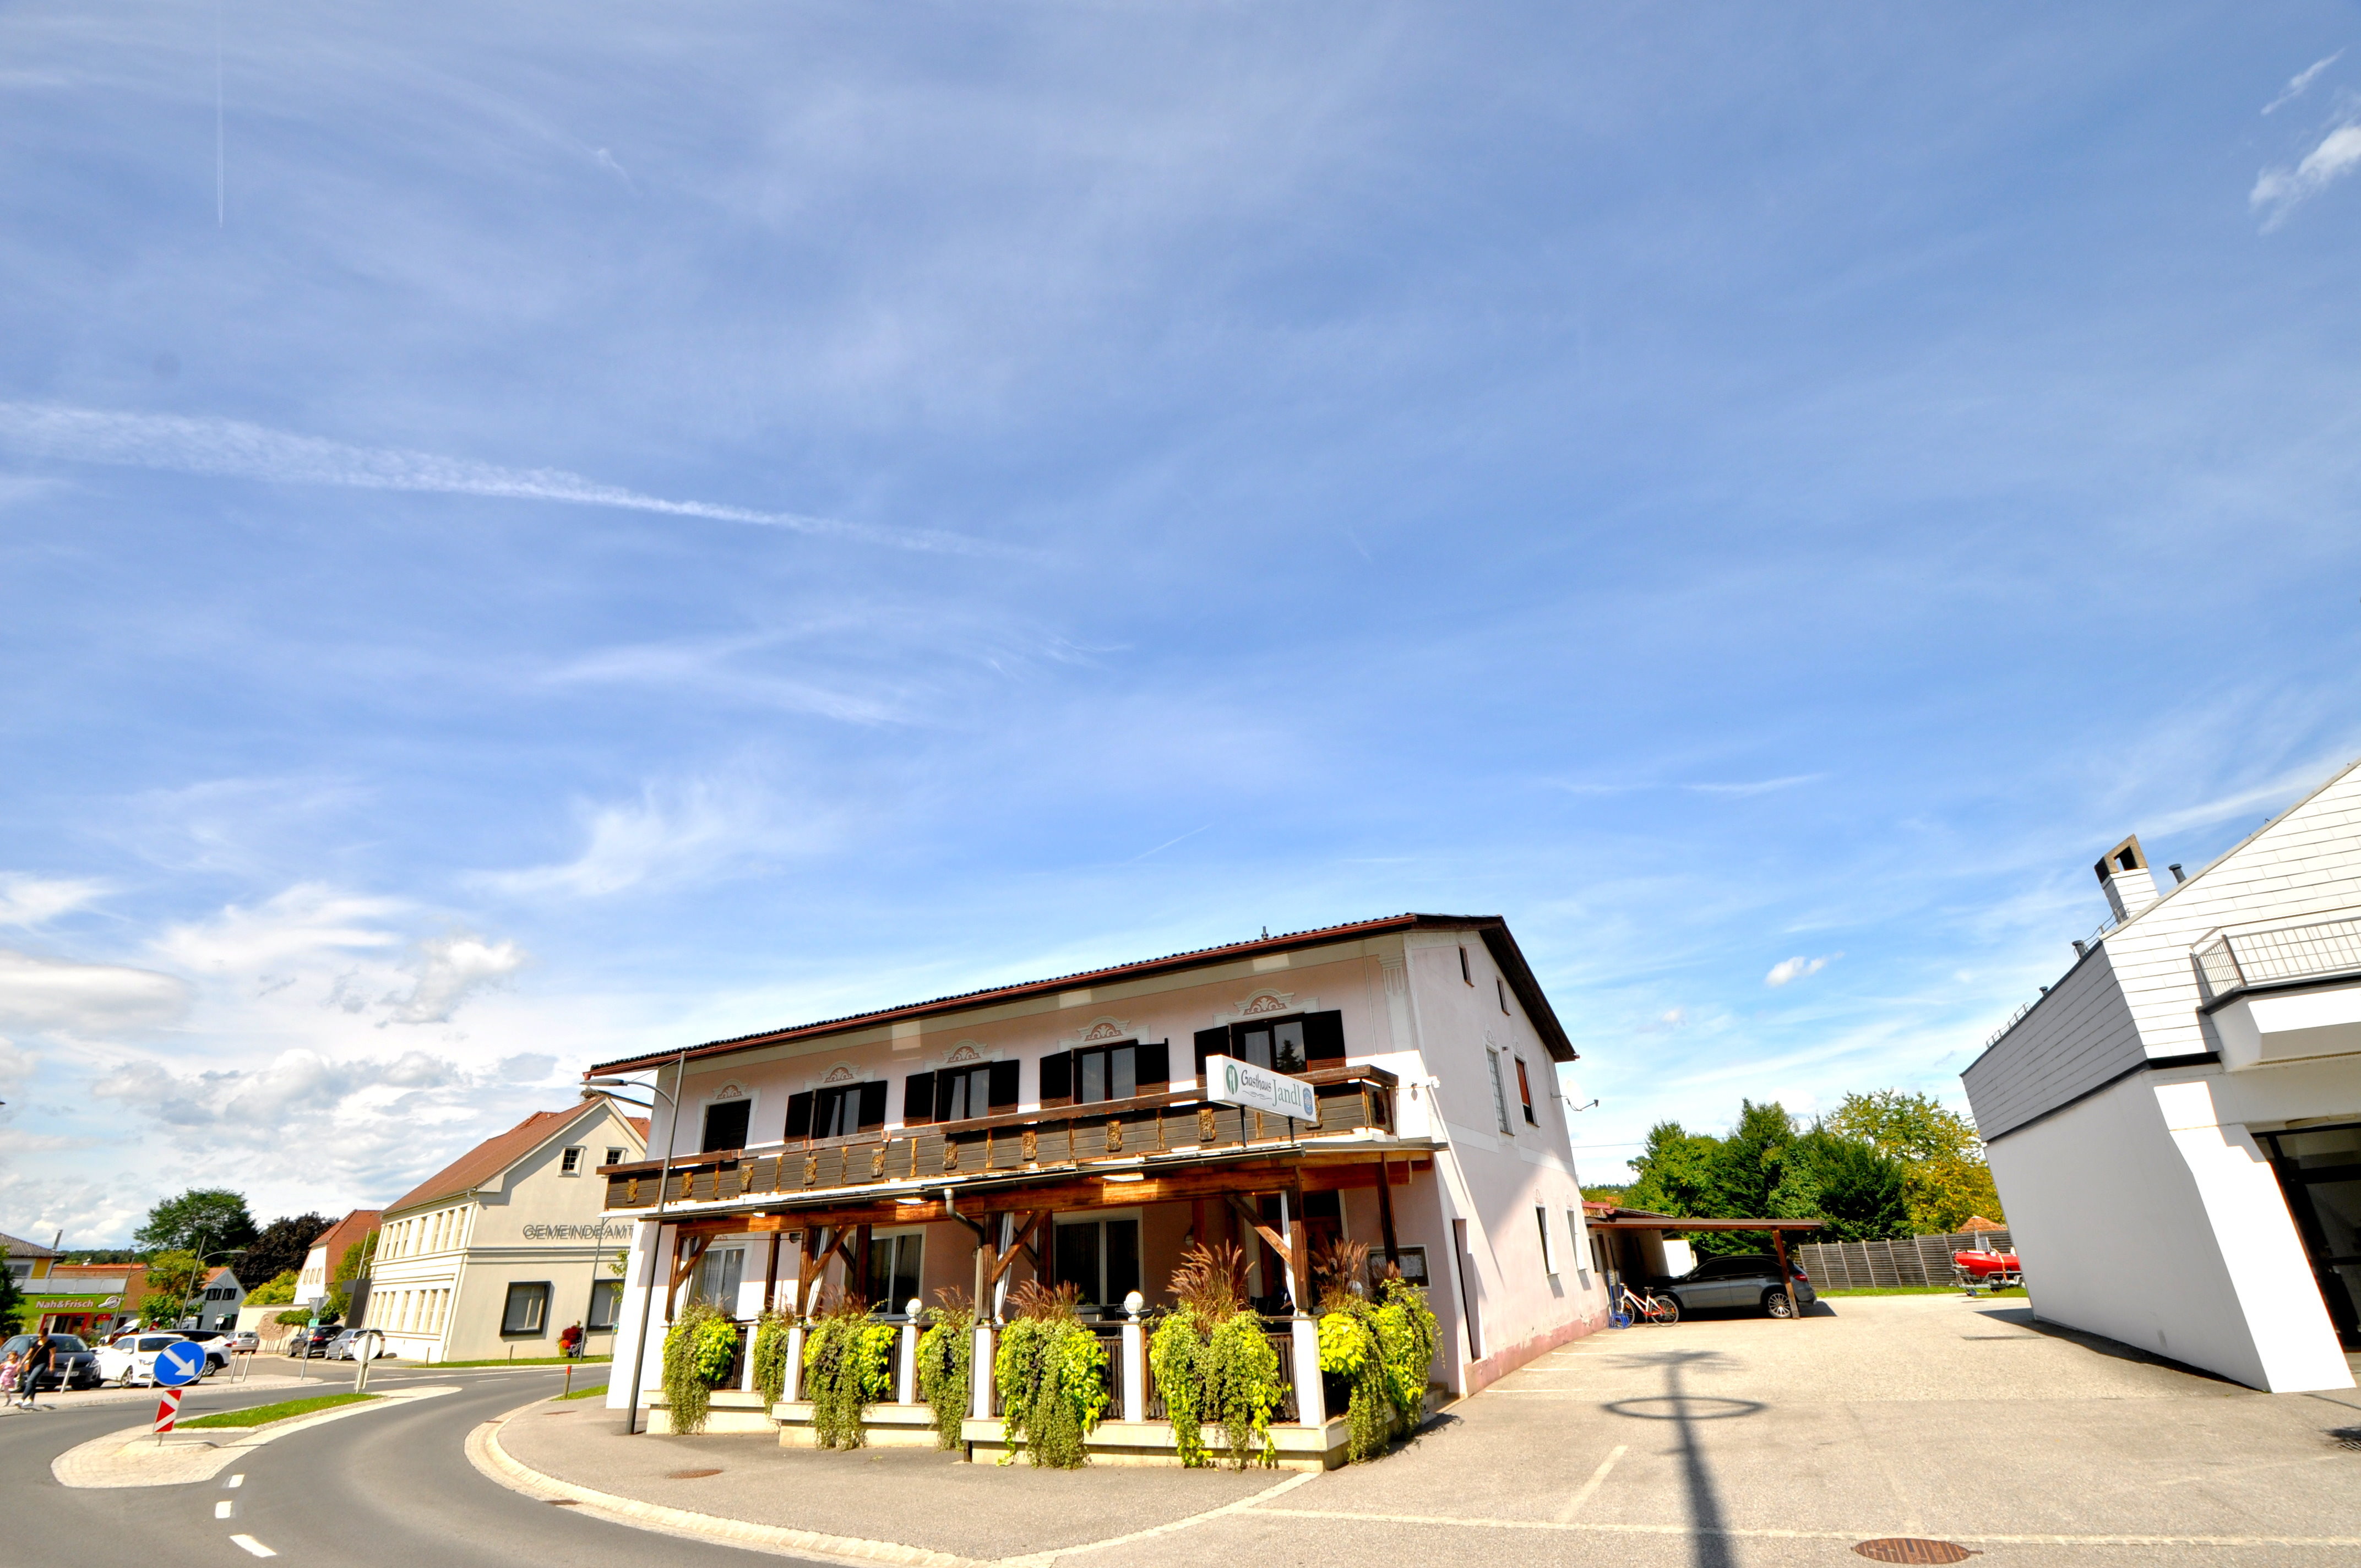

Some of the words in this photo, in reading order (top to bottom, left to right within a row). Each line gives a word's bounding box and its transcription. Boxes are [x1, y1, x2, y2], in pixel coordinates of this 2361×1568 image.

[1241, 1069, 1271, 1092] Gasthaus
[1272, 1079, 1302, 1107] Jandl
[523, 1224, 634, 1239] GEMEINDEAMT
[36, 1299, 94, 1309] Nah&Frisch
